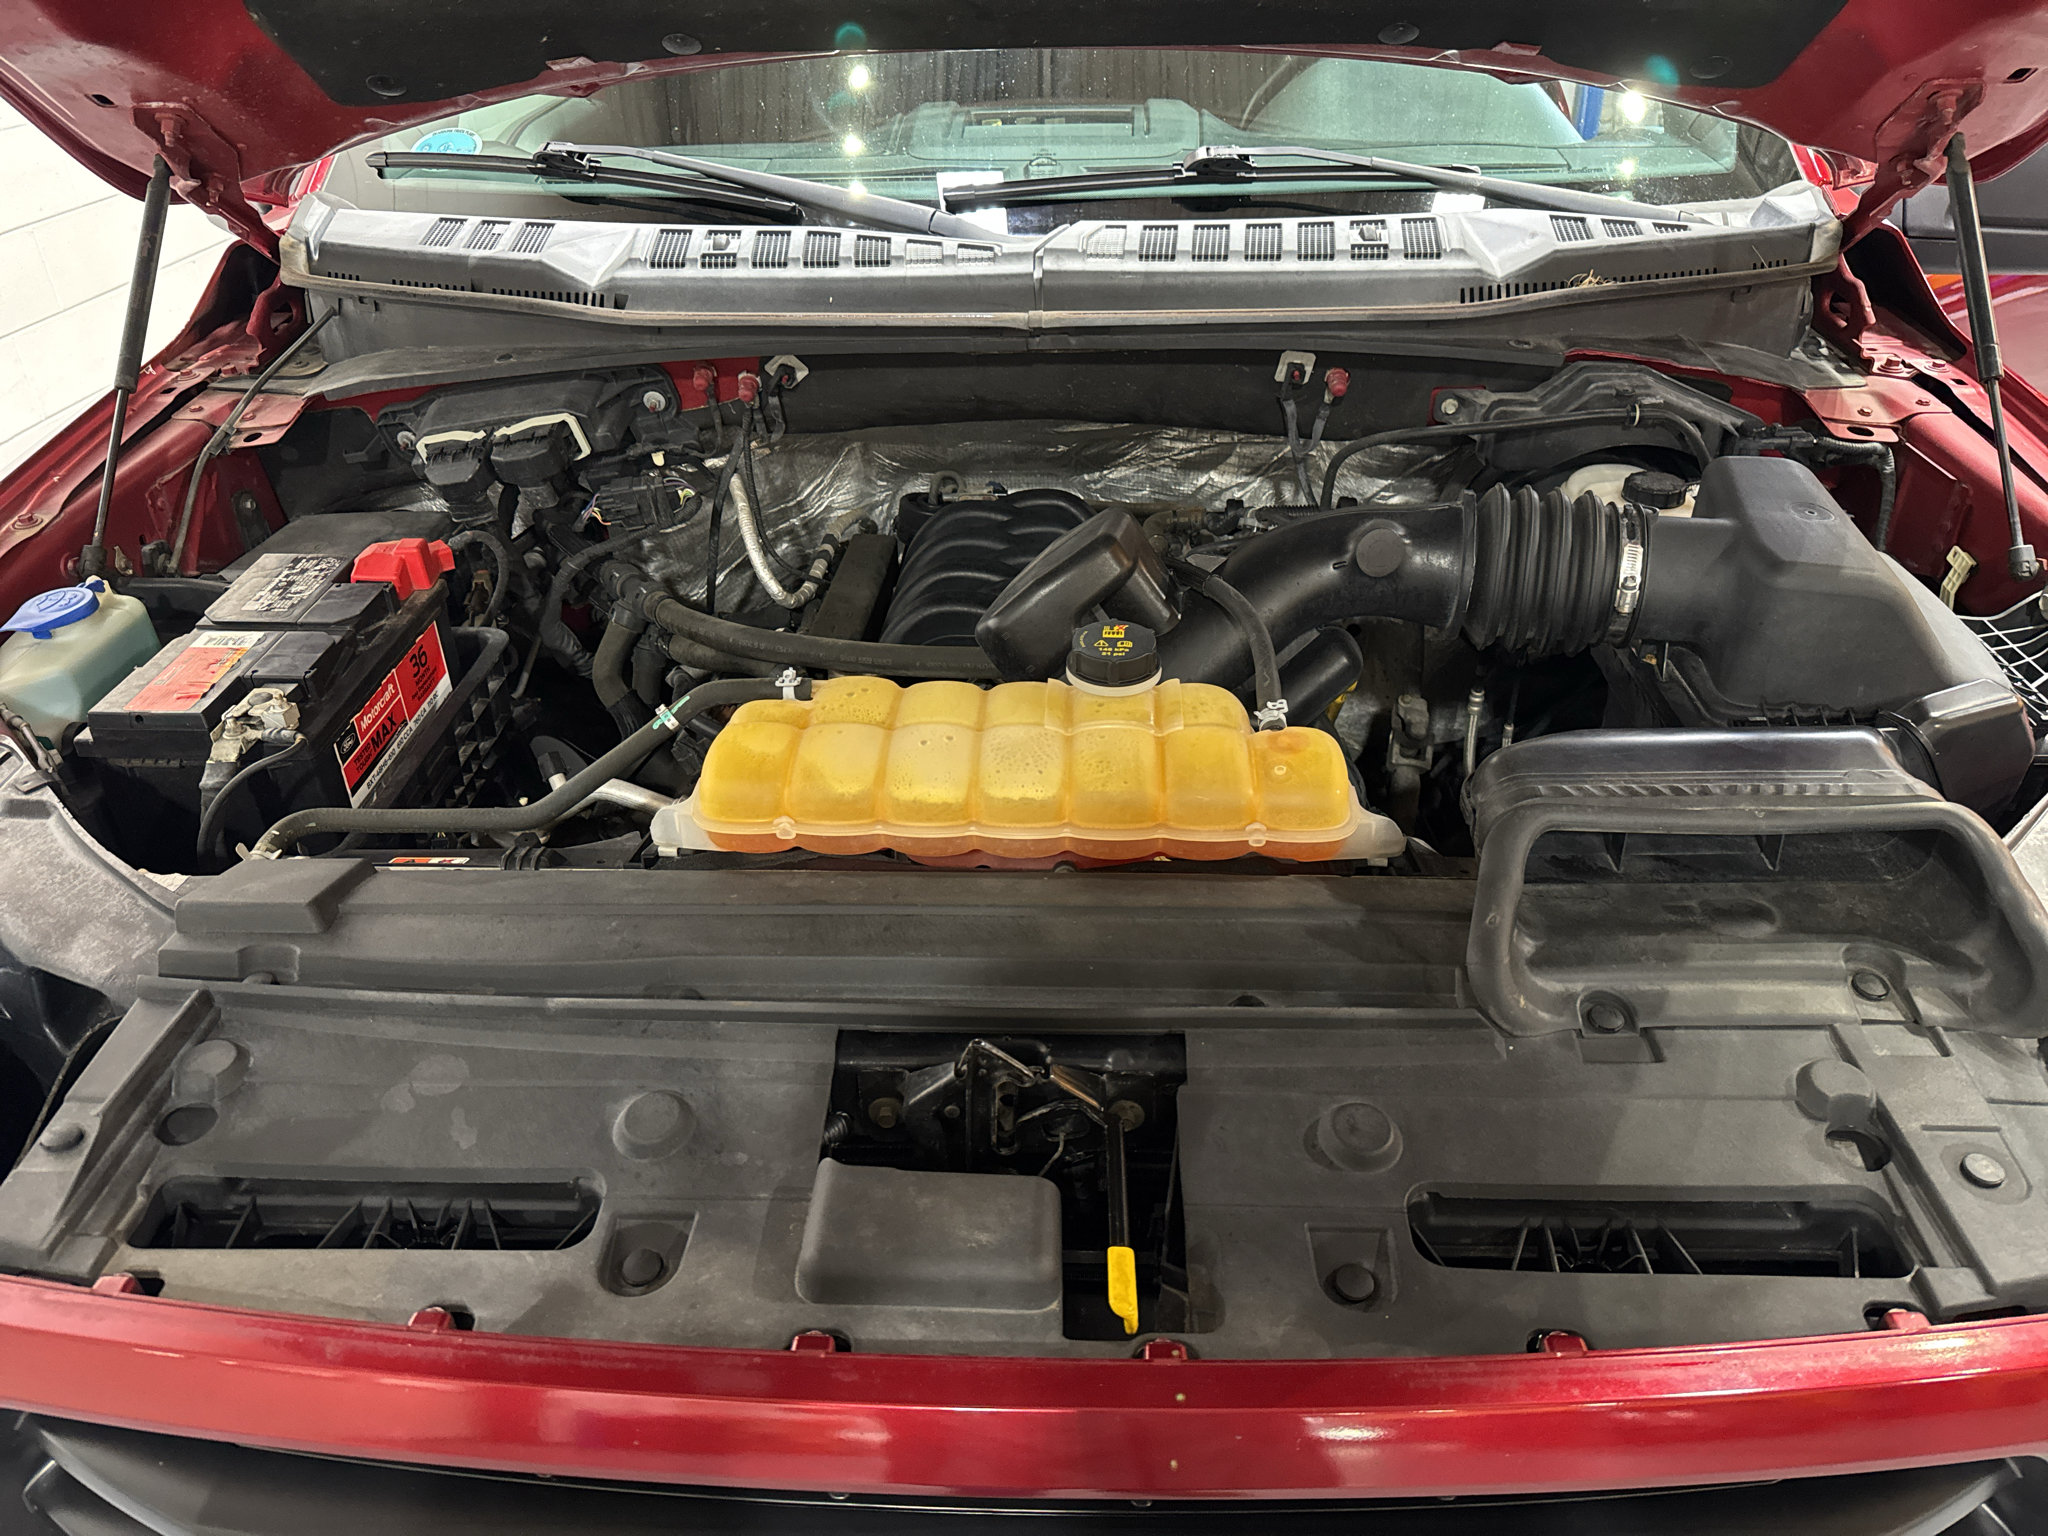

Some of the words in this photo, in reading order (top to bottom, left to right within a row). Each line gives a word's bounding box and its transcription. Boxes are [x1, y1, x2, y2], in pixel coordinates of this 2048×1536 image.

[409, 644, 427, 678] 36
[415, 665, 431, 686] MONTH
[360, 683, 396, 732] Motorcraft
[370, 712, 398, 753] MAX
[403, 726, 413, 743] CCA
[353, 742, 372, 767] TESTED
